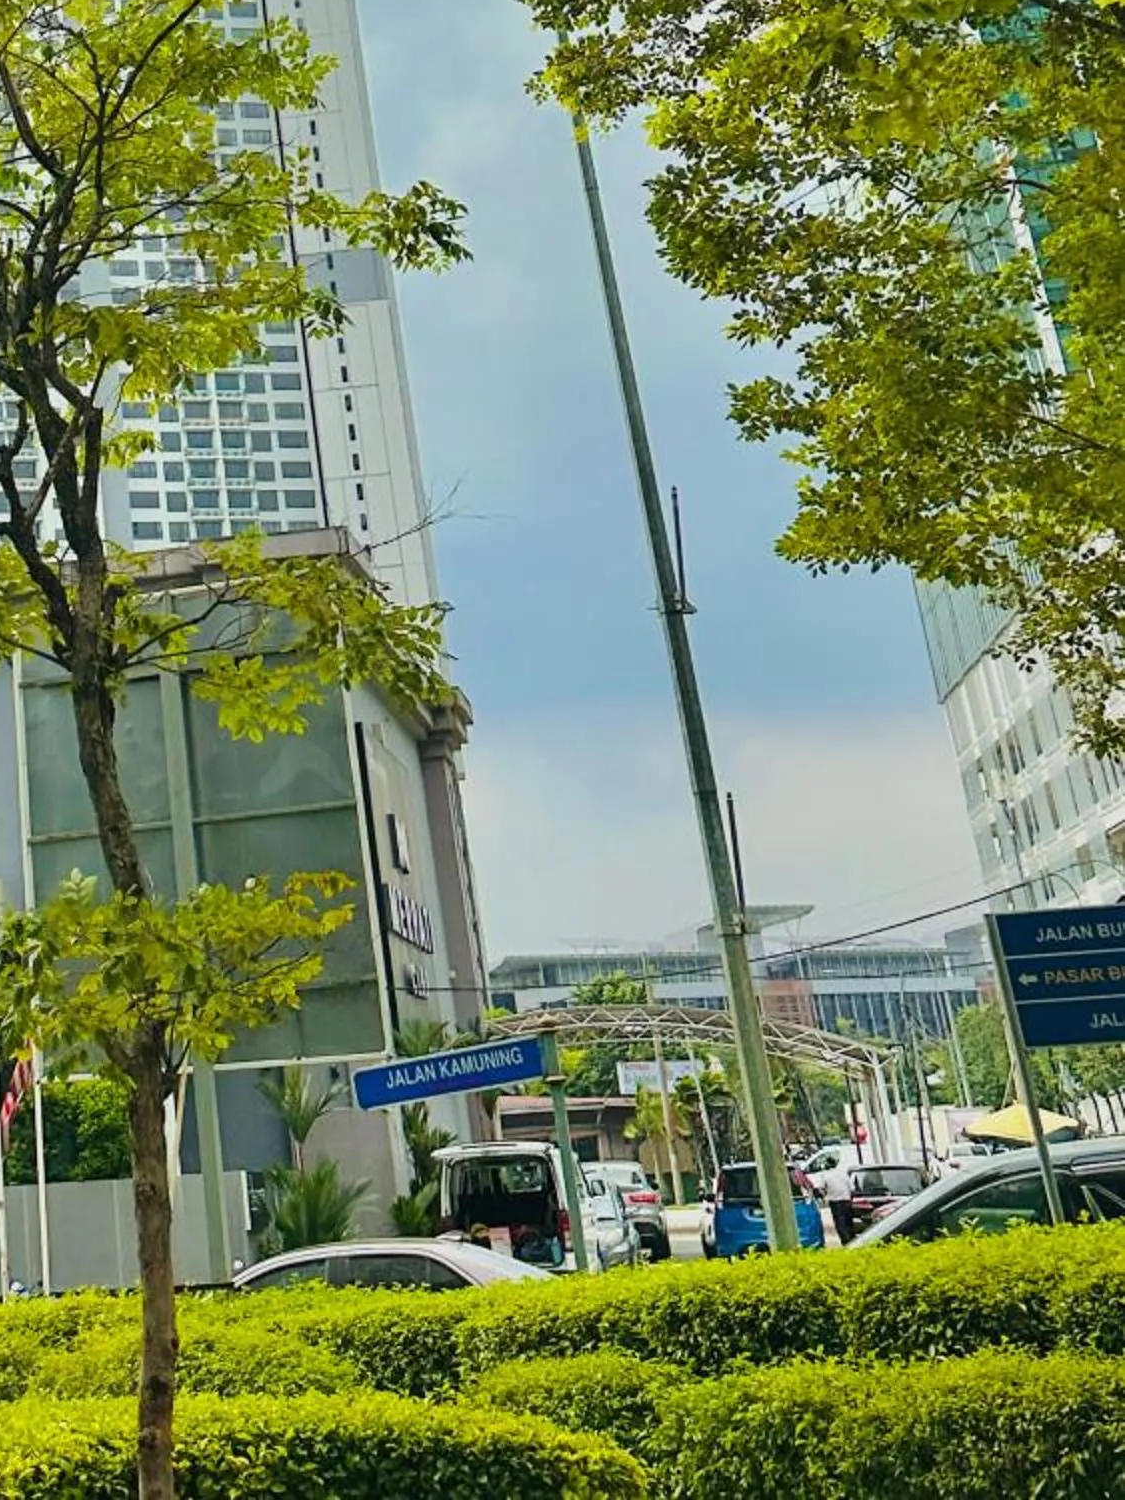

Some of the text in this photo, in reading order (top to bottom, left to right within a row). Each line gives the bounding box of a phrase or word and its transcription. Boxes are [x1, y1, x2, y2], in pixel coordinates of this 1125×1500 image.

[1035, 921, 1125, 942] JALAN BU
[1043, 968, 1104, 985] PASAR
[1089, 1012, 1125, 1029] JAL
[386, 1047, 523, 1089] JALAN KAMUNING
